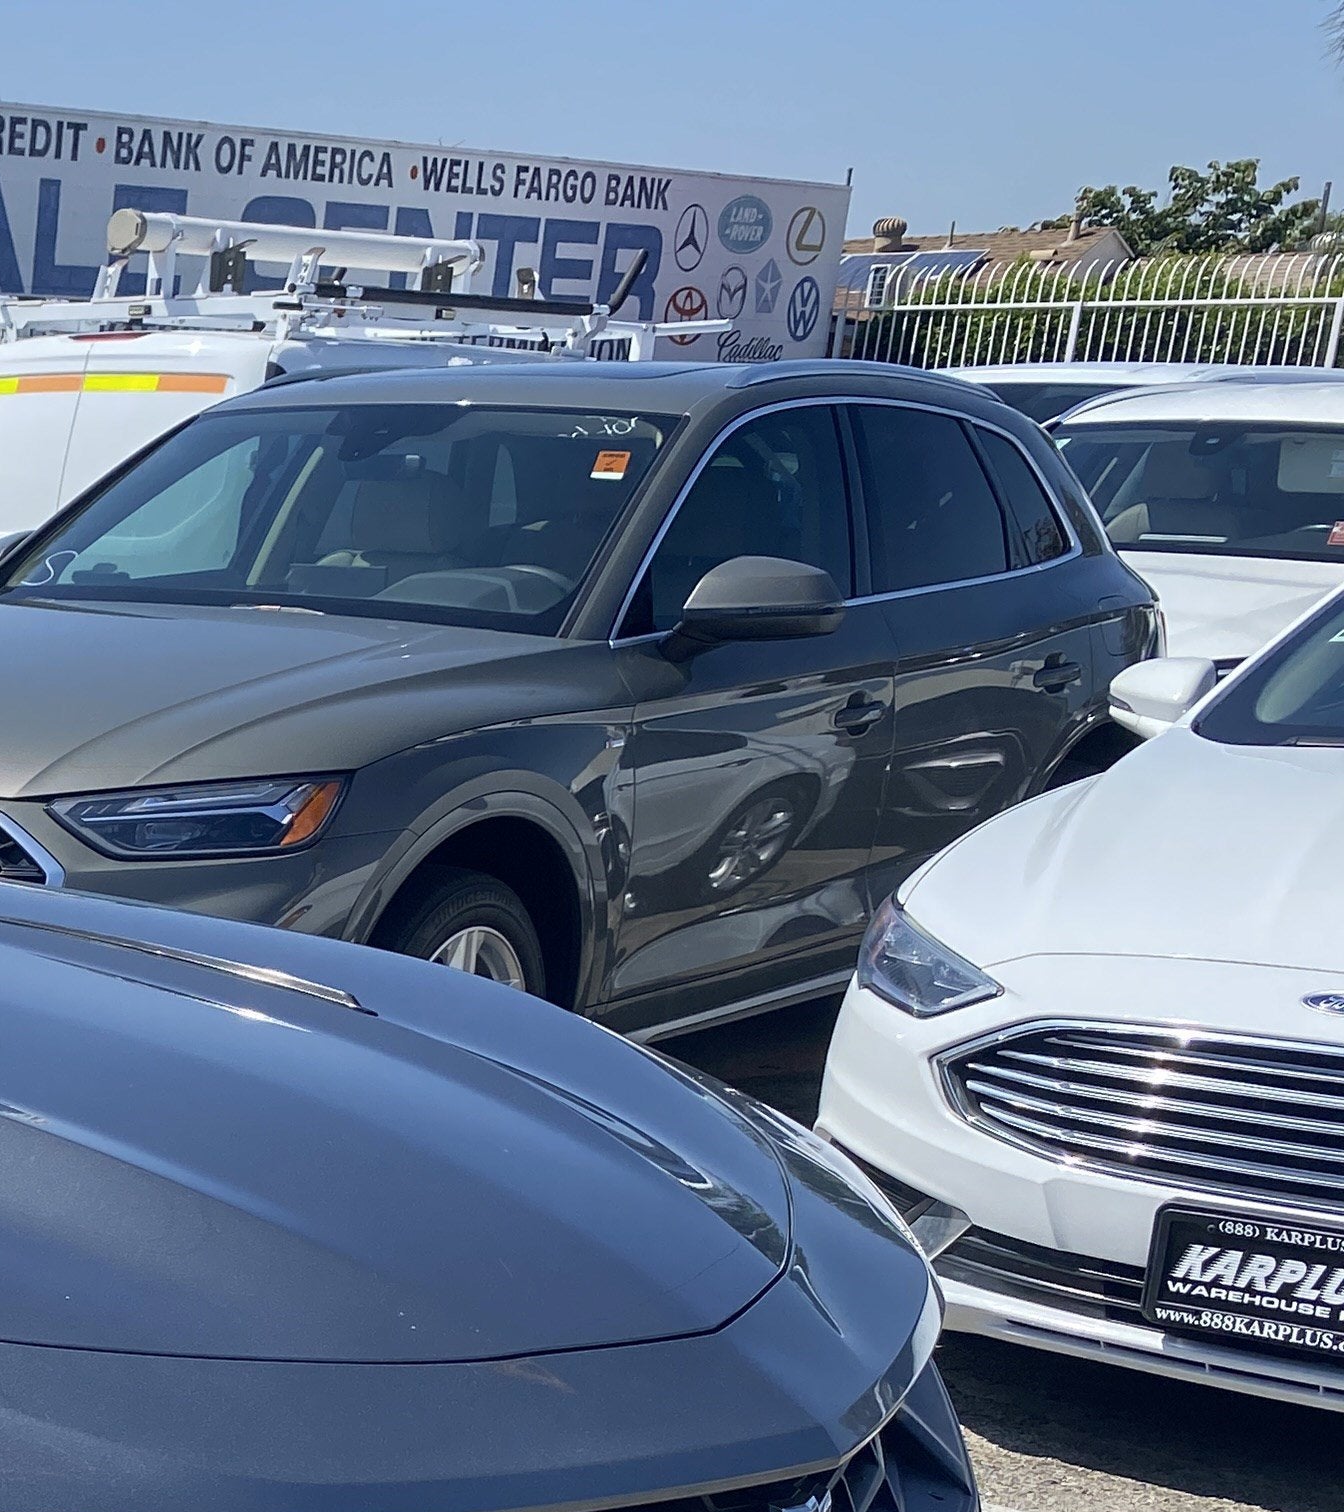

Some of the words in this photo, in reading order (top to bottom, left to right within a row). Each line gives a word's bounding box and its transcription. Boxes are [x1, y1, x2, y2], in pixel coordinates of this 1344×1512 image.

[115, 127, 203, 172] BANK
[215, 136, 254, 177] OF
[260, 142, 395, 188] AMERICA
[421, 156, 505, 197] WELLS
[515, 165, 597, 204] FARGO
[605, 173, 672, 211] BANK
[717, 330, 783, 363] Cadillac
[1218, 1220, 1260, 1238] (888)
[1167, 1280, 1331, 1319] WAREHOUSE
